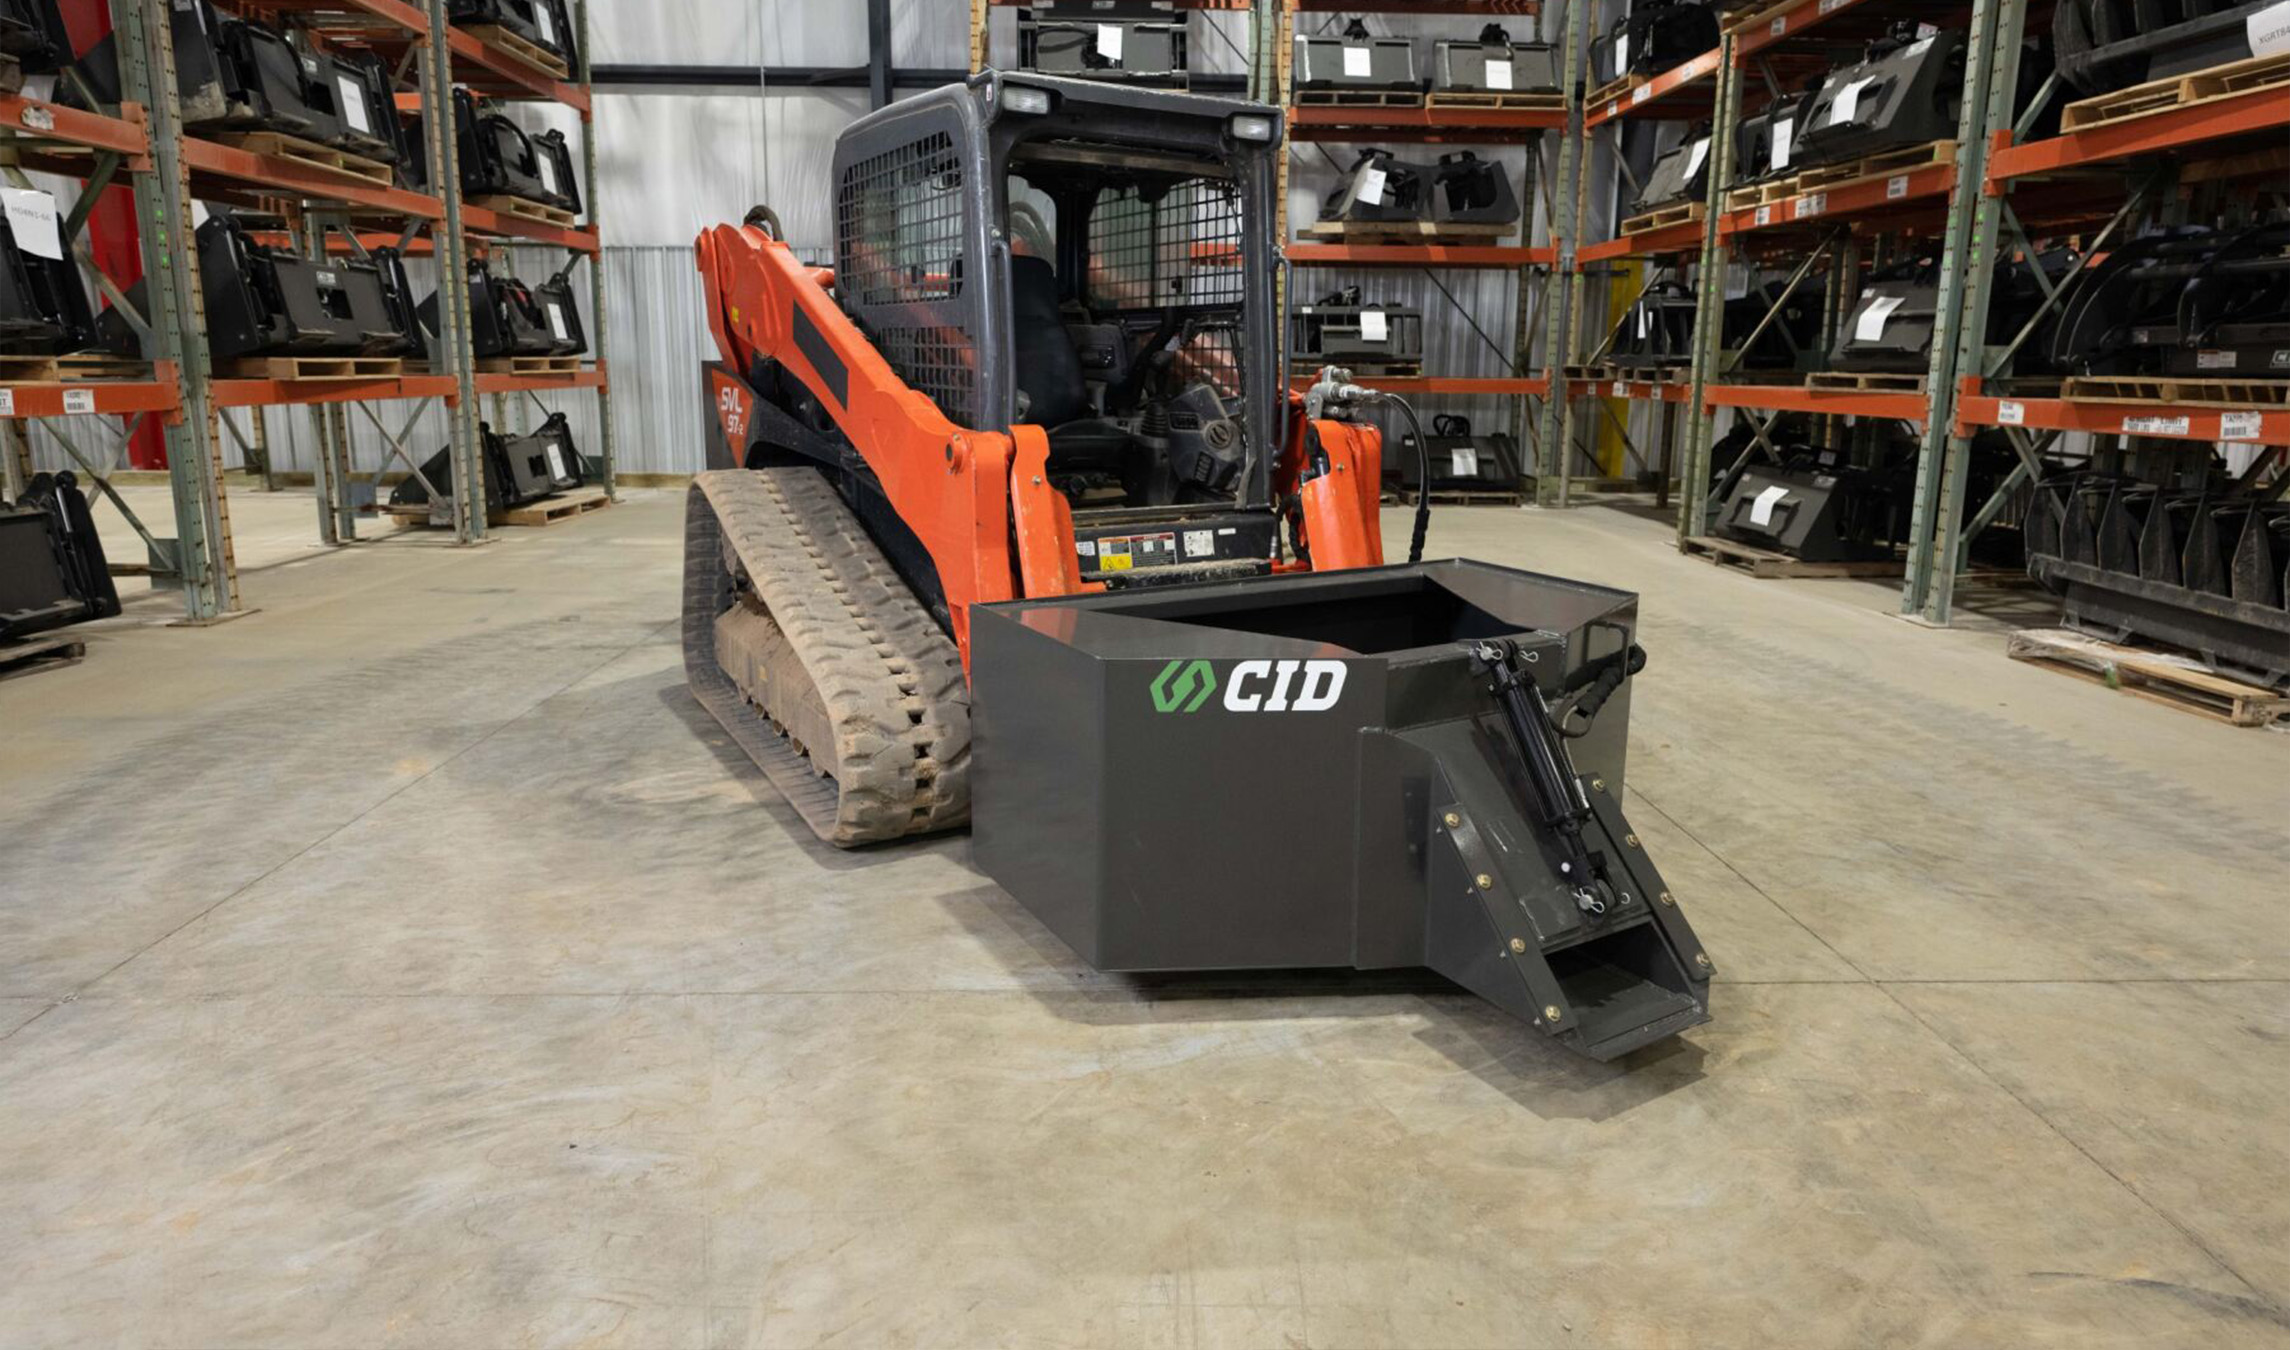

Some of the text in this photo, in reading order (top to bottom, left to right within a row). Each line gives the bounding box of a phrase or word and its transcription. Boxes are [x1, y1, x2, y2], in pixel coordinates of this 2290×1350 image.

[721, 386, 743, 414] SVL
[727, 413, 744, 435] 97-2
[1223, 660, 1348, 712] CID
